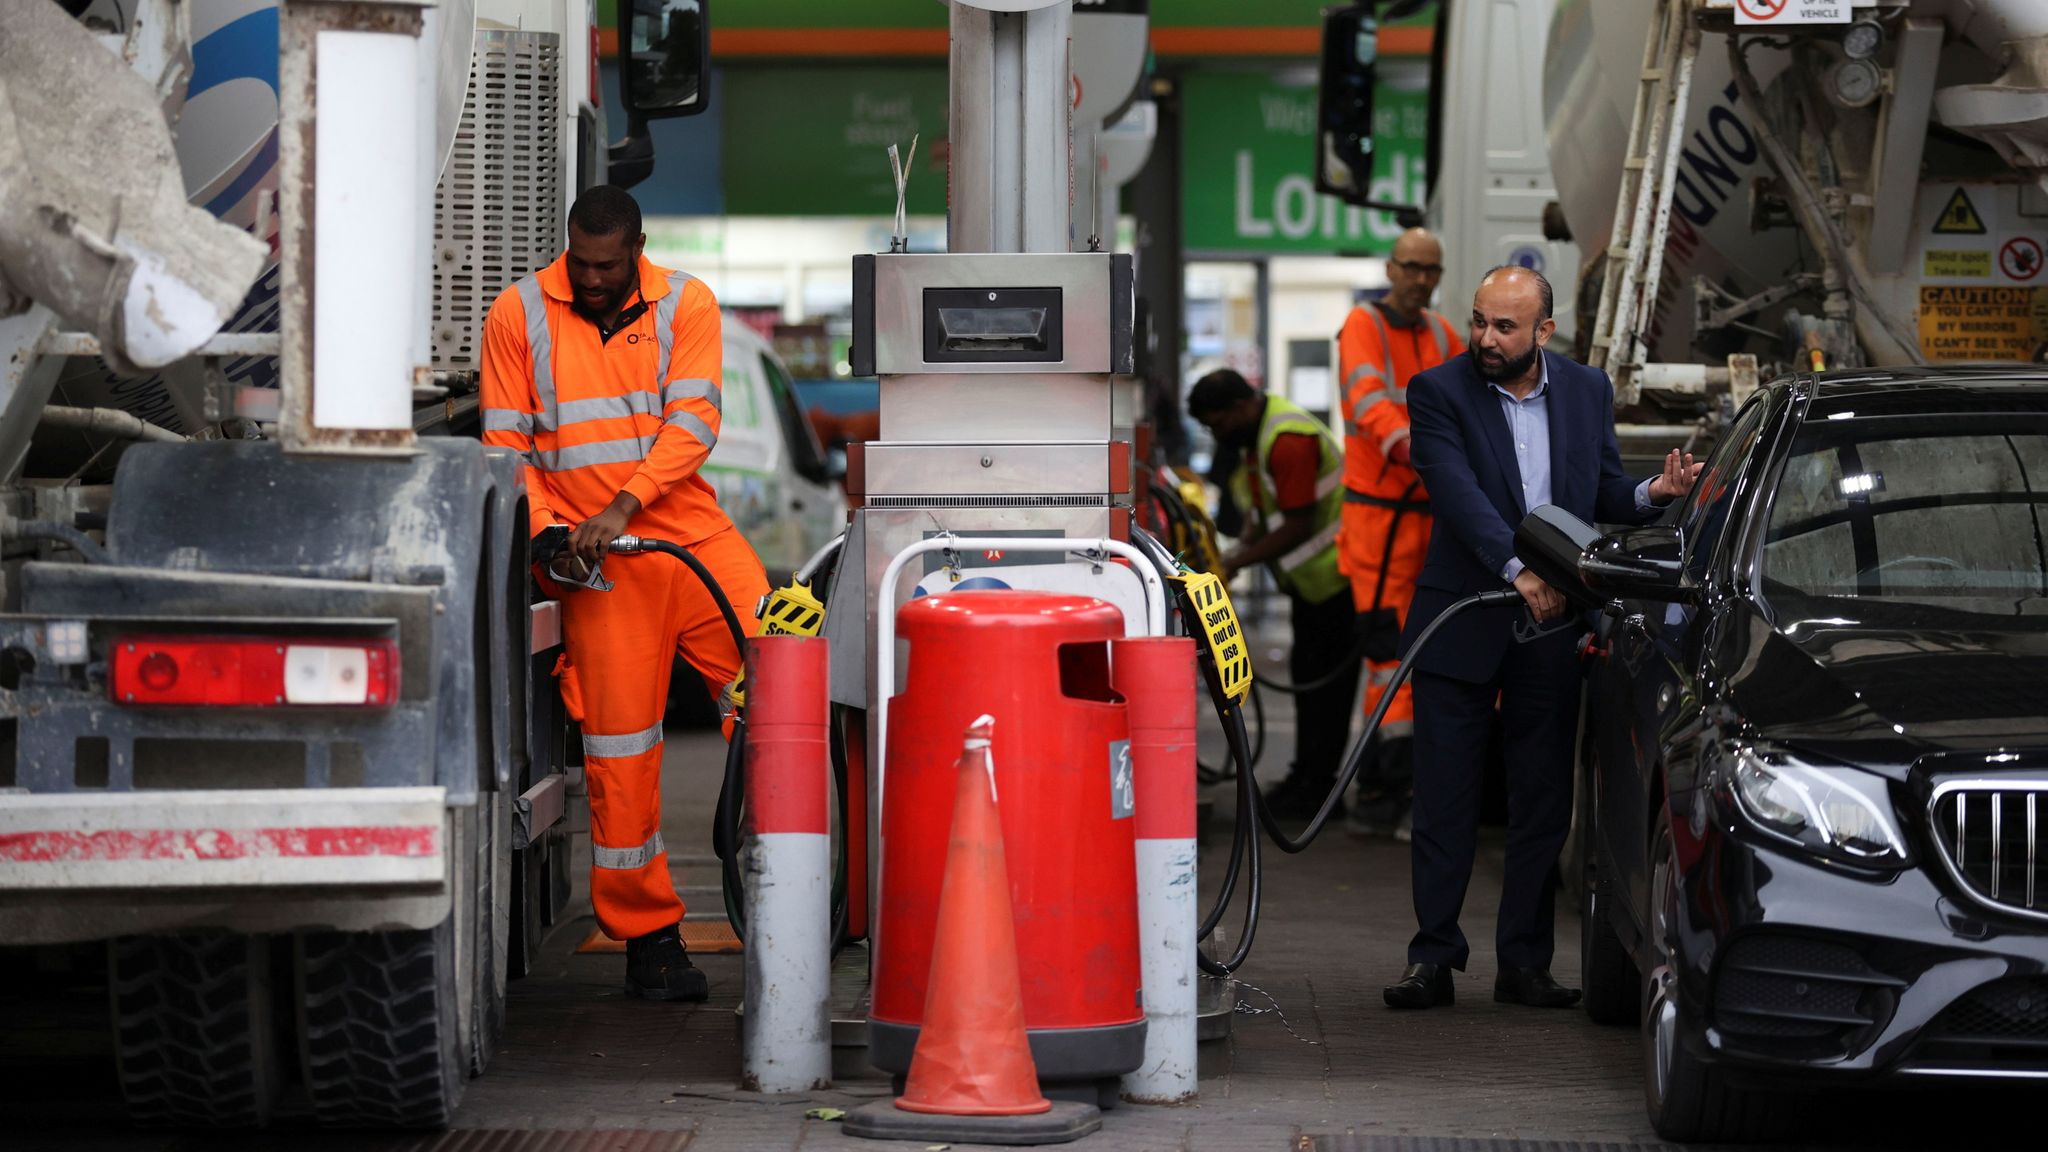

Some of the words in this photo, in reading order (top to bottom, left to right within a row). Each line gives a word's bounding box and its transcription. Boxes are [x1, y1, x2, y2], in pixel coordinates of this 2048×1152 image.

[1800, 9, 1840, 18] VEHICLE
[1927, 251, 1957, 261] Blind
[1961, 252, 1988, 262] spot
[1923, 288, 2029, 304] CAUTION
[1921, 306, 1932, 316] IF
[1938, 306, 1962, 317] YOU
[1966, 306, 2003, 317] CAN'T
[2007, 306, 2031, 317] SEE
[1937, 322, 1956, 332] MY
[1960, 322, 2017, 333] MIRRORS
[1934, 337, 1970, 348] CAN'T
[1975, 337, 1998, 348] SEE
[1206, 606, 1230, 627] Sorry
[1213, 627, 1228, 645] out
[1228, 621, 1237, 637] of
[1222, 644, 1238, 661] use
